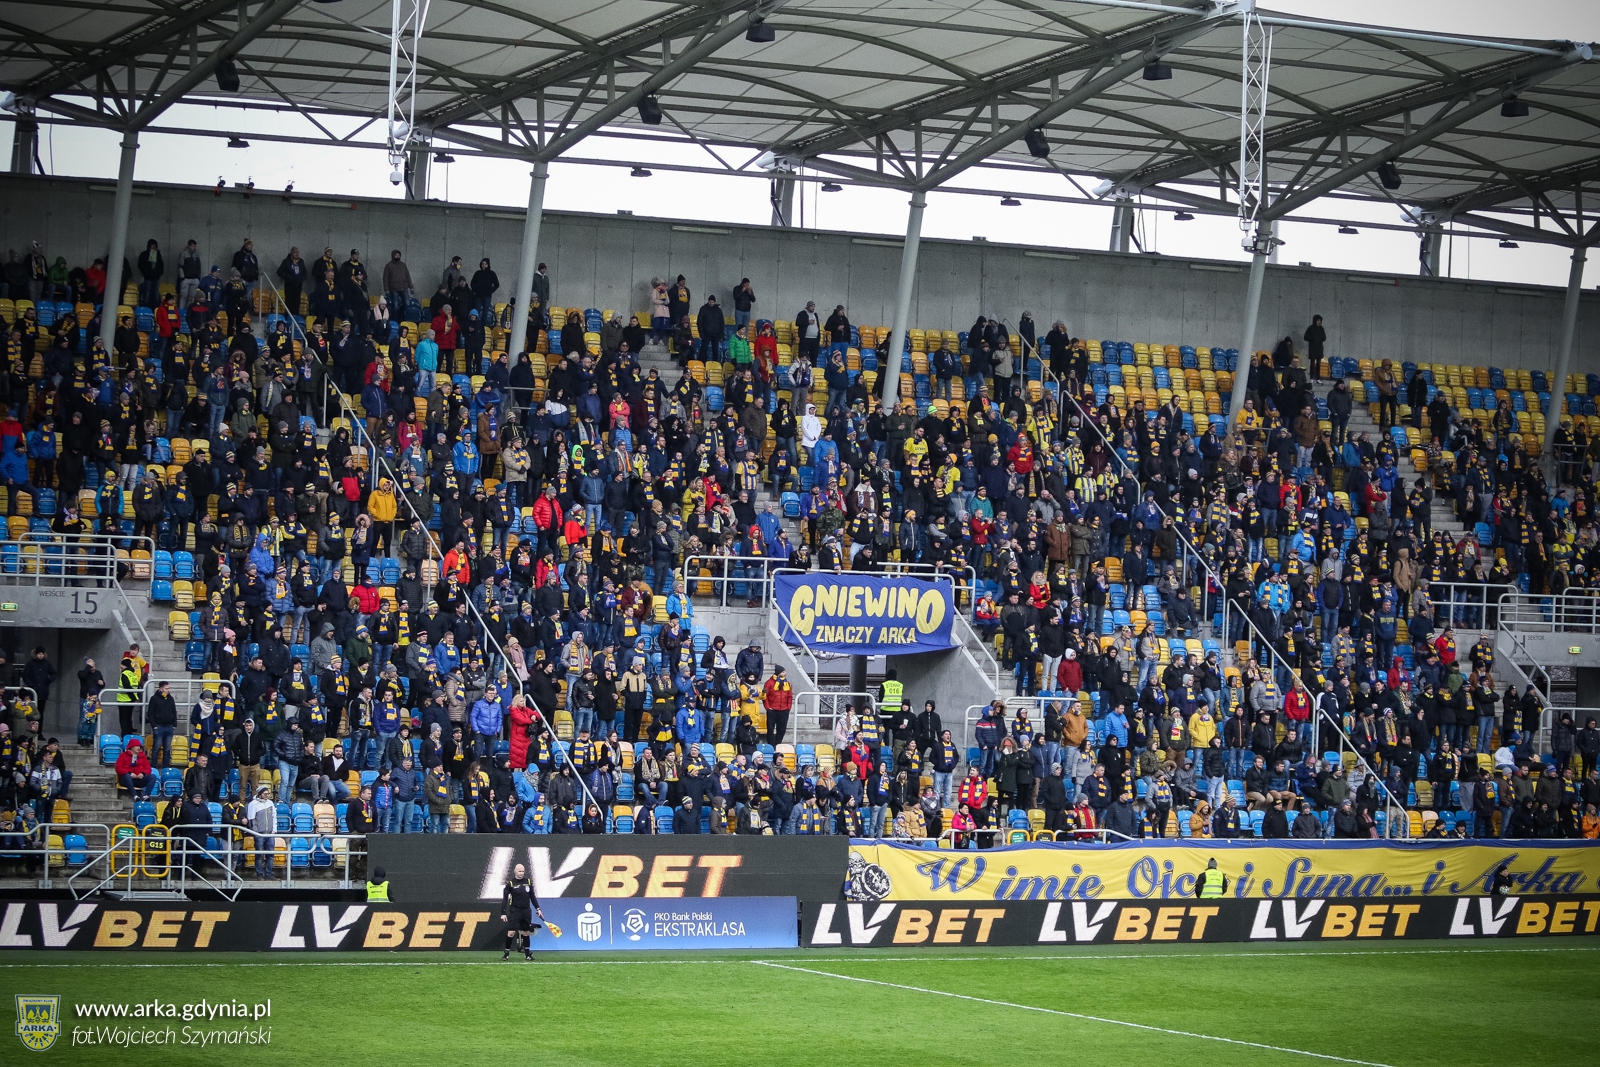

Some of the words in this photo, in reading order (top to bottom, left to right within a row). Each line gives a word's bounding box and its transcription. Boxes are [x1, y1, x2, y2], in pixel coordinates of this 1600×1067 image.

[70, 591, 98, 615] 15
[789, 584, 946, 636] GNIEWINO
[815, 625, 874, 643] ZNACZY
[877, 626, 918, 644] ARKA
[149, 841, 164, 849] G15
[915, 855, 988, 894] W
[993, 863, 1105, 899] imie
[1126, 855, 1232, 899] Ojc
[1234, 861, 1256, 898] i
[1421, 860, 1447, 896] i
[654, 912, 670, 921] PKO
[671, 912, 690, 921] Bank
[691, 911, 713, 921] Polski
[654, 922, 746, 937] EKSTRAKLASA
